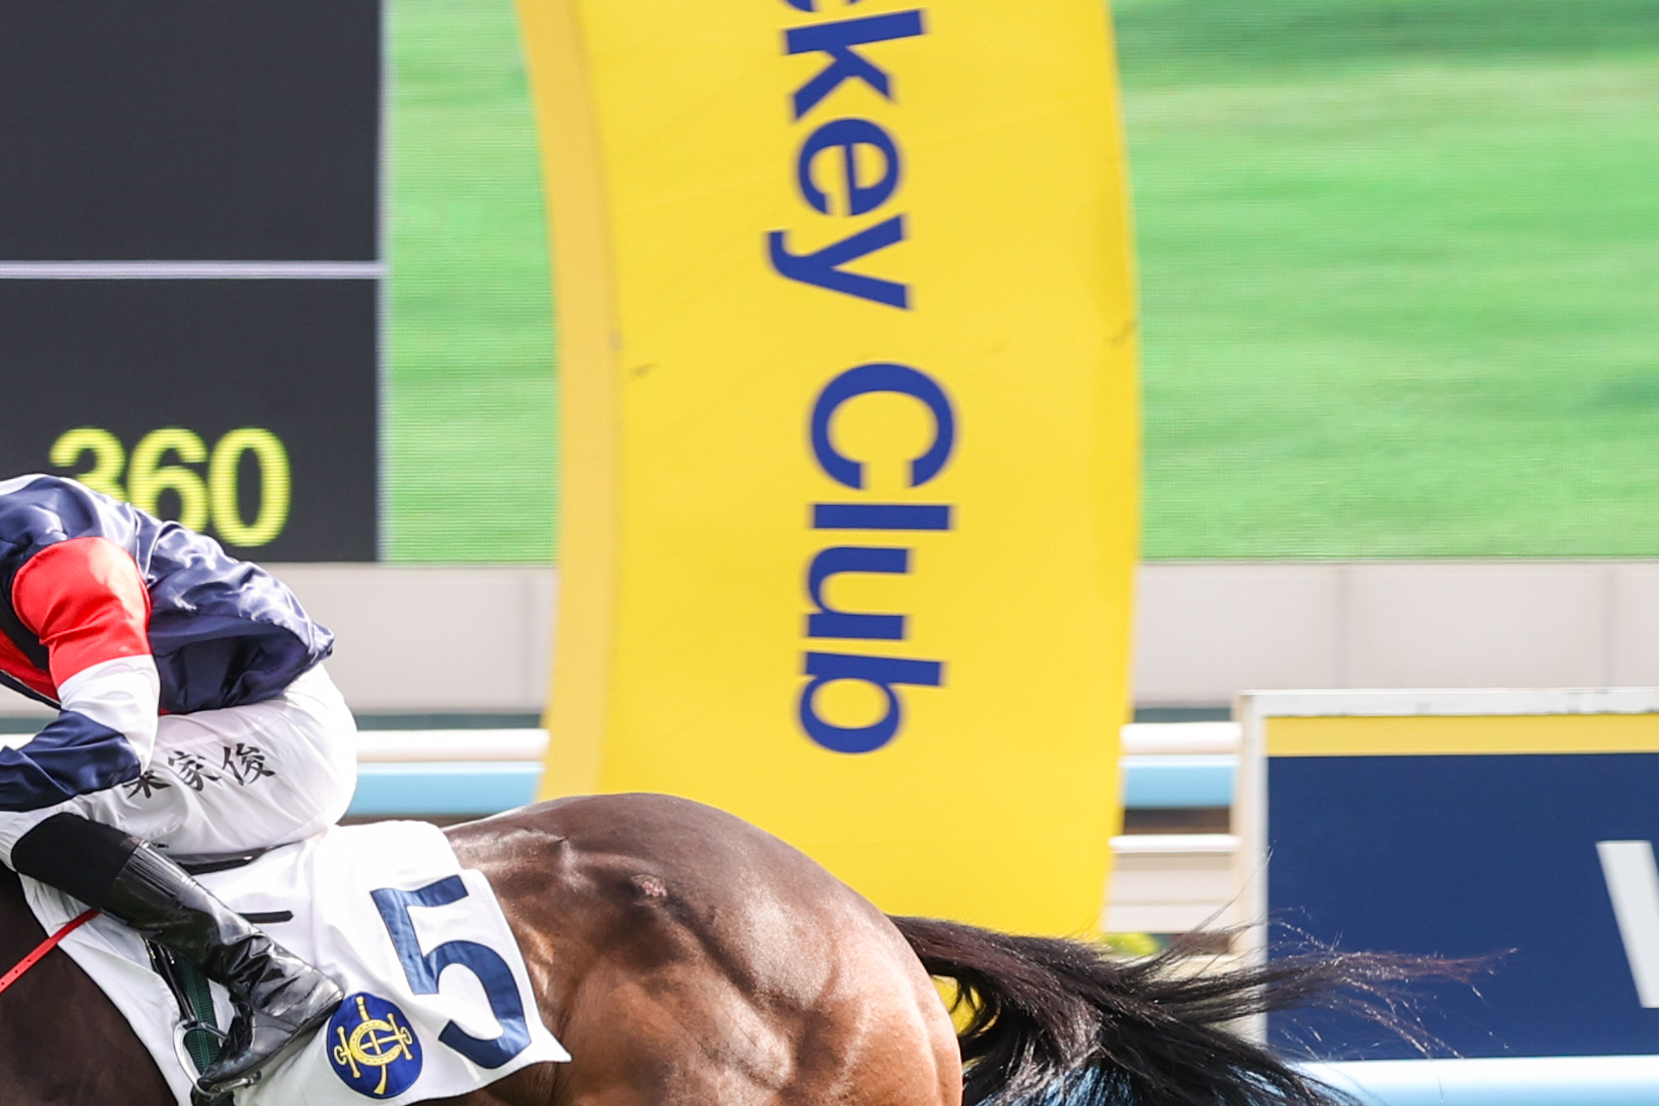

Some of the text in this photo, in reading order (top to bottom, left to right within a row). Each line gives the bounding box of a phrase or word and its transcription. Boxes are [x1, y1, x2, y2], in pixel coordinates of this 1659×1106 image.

[765, 0, 959, 756] key Club
[370, 873, 532, 1070] 5
